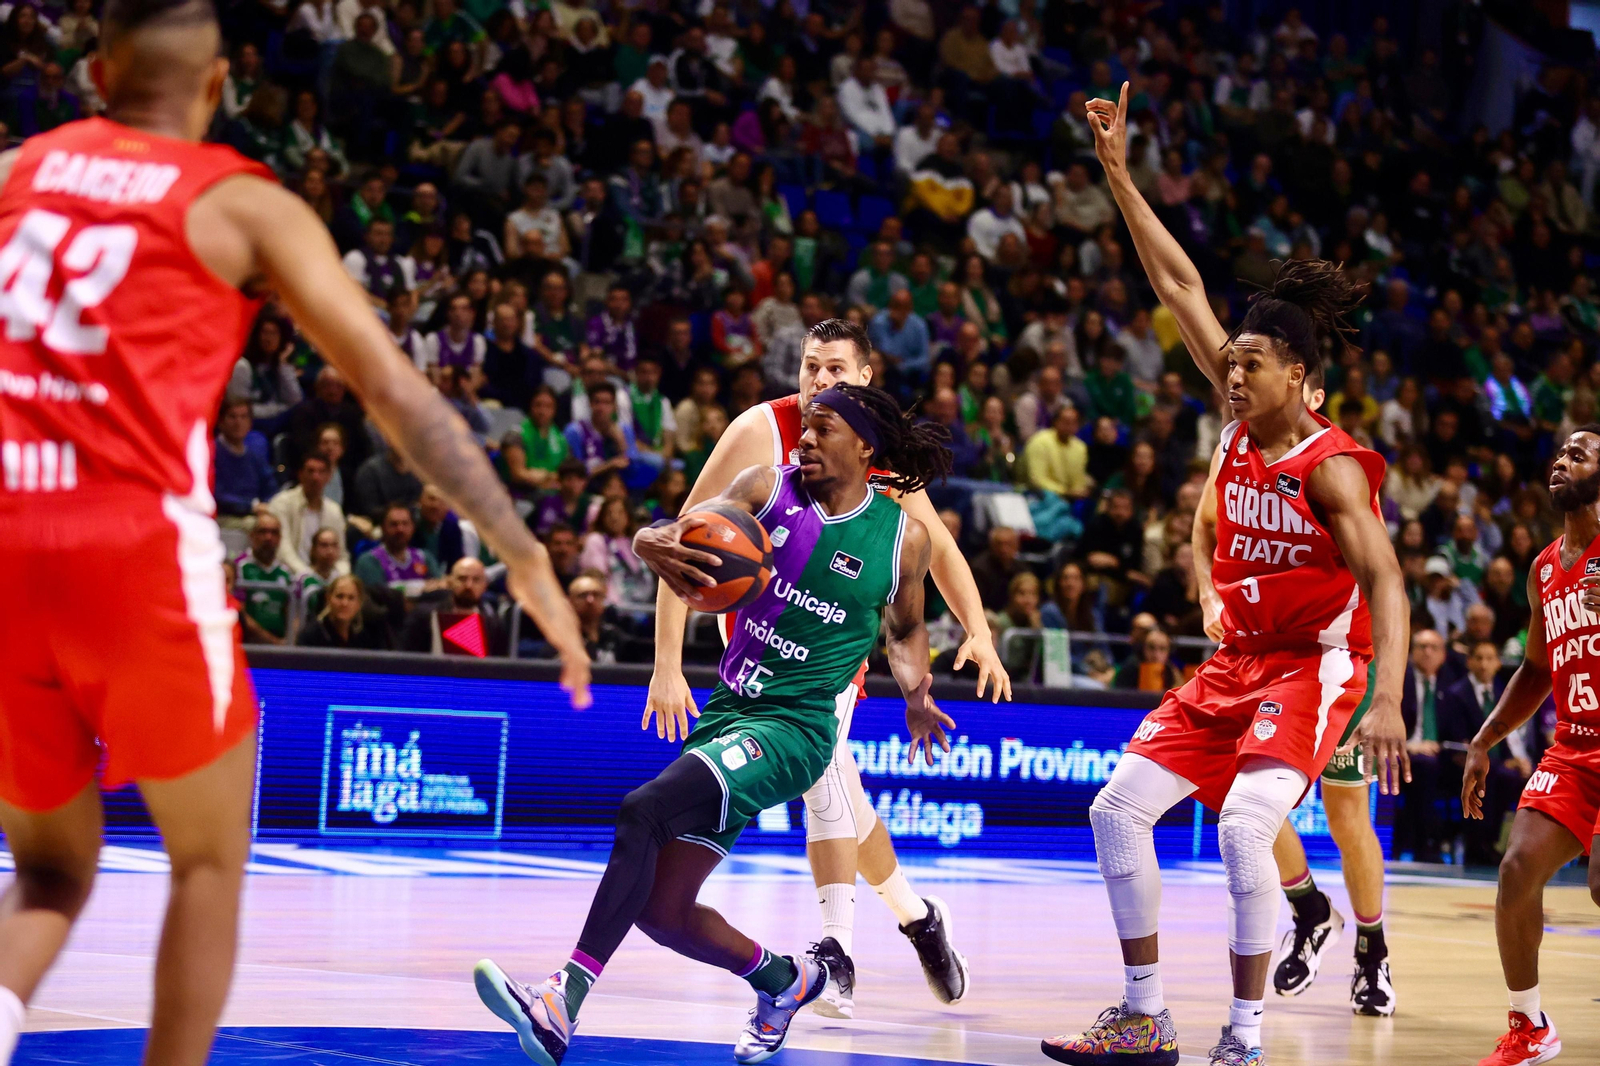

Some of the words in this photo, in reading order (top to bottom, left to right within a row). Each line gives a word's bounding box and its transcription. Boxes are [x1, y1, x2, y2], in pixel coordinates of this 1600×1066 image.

[0, 208, 139, 356] 42
[1229, 533, 1312, 567] FIATC
[833, 563, 857, 577] endesa
[773, 577, 847, 625] Unicaja
[1568, 672, 1599, 713] 25
[1133, 718, 1166, 742] SOY
